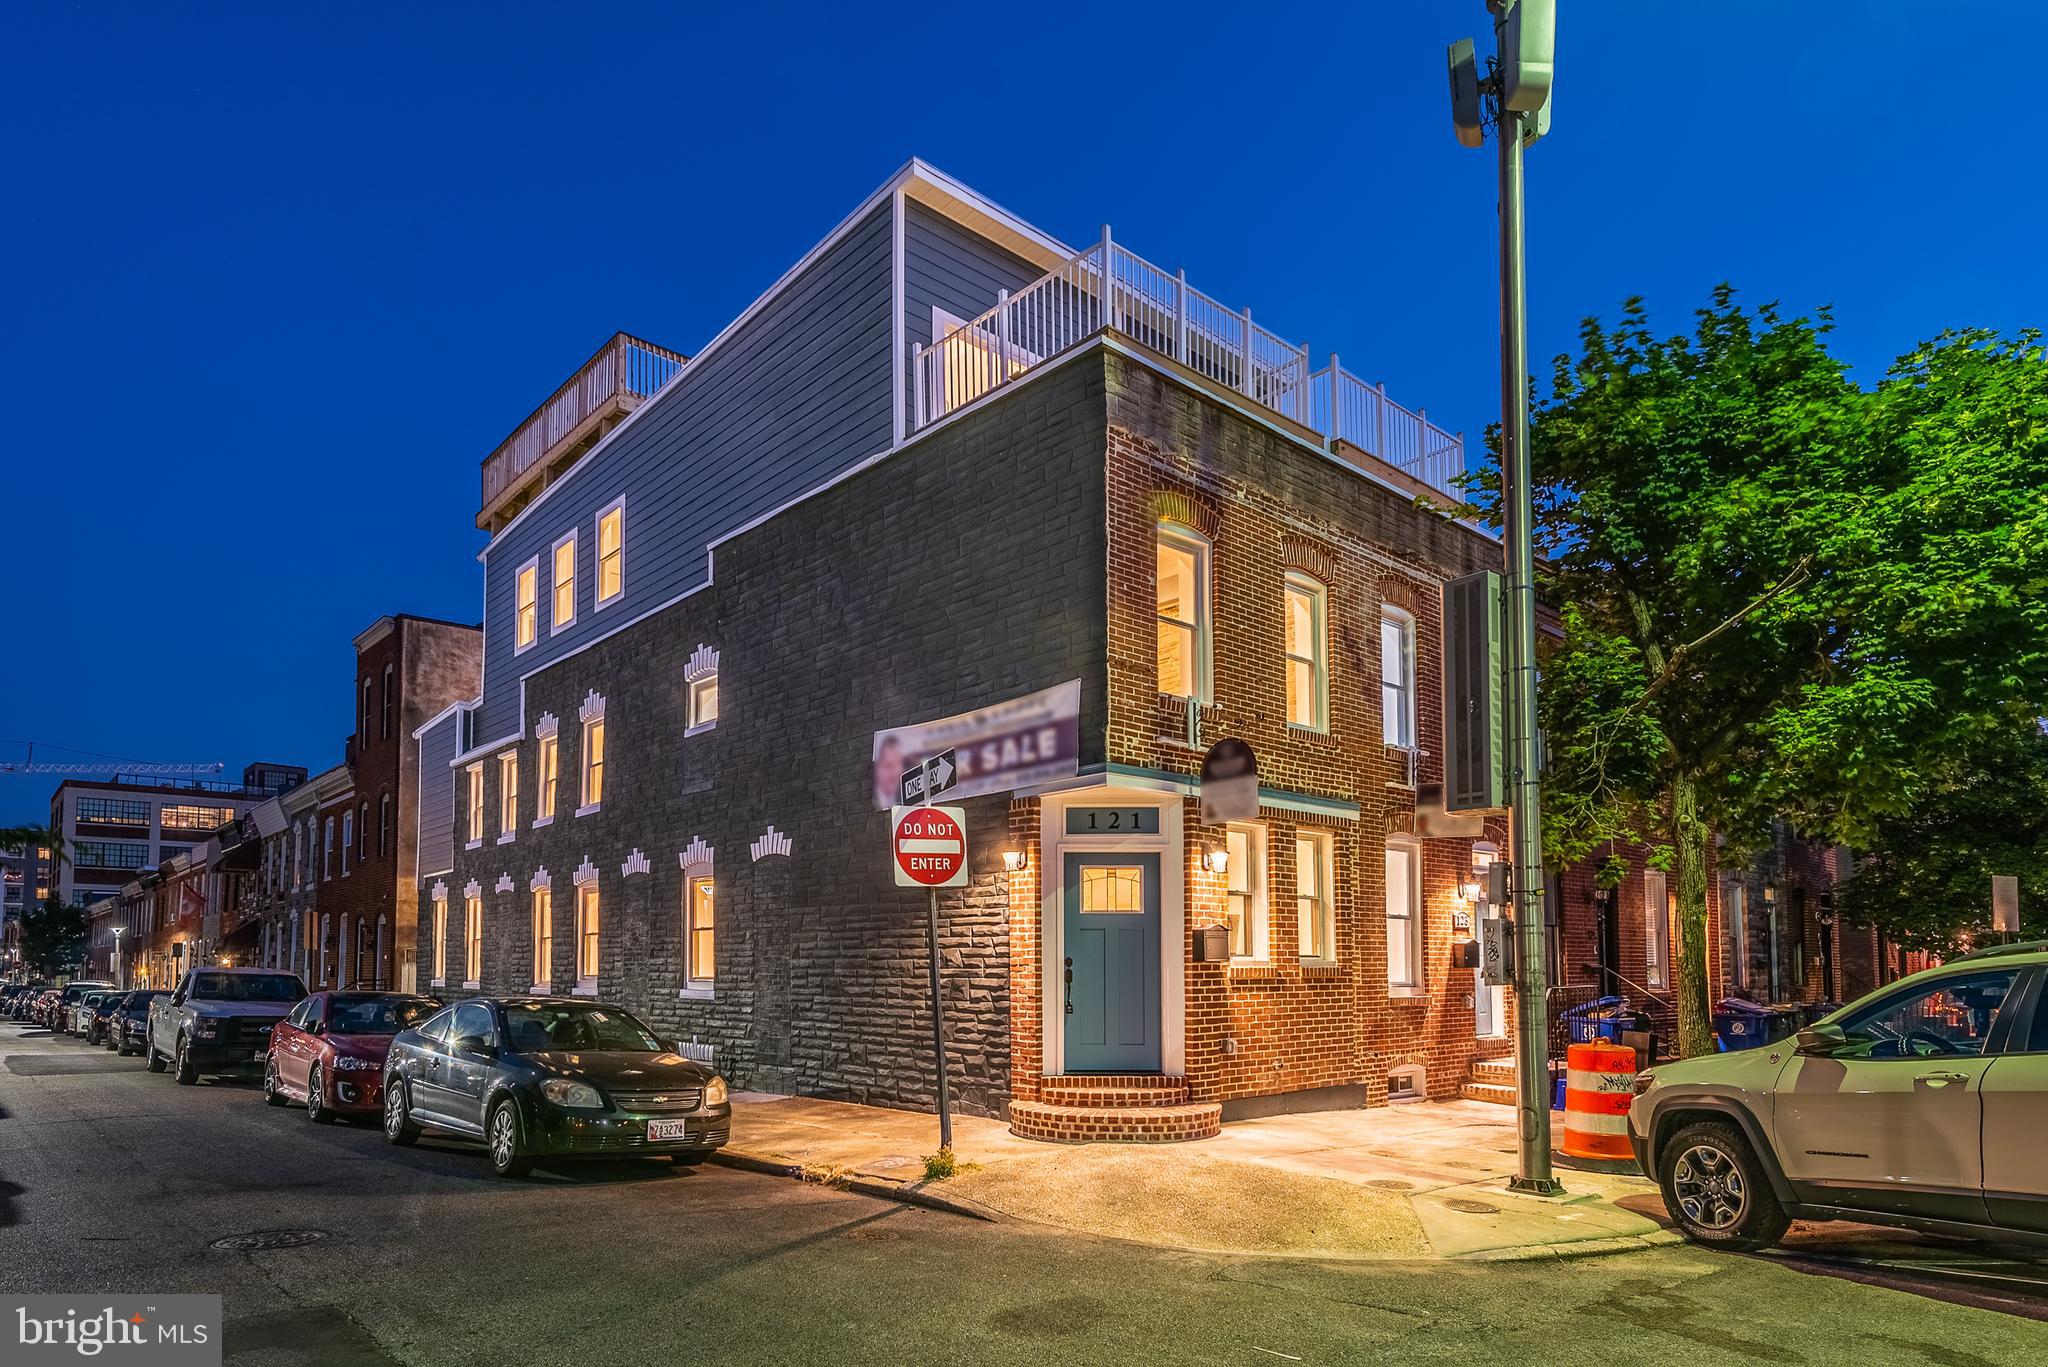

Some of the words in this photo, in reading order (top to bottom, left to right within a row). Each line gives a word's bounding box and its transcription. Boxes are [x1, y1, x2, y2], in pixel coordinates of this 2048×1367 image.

[981, 728, 1058, 771] SALE
[906, 777, 922, 797] ONE
[929, 767, 940, 787] AY
[904, 822, 922, 836] DO
[927, 823, 954, 836] NOT
[1087, 811, 1142, 830] 121
[911, 857, 952, 870] ENTER
